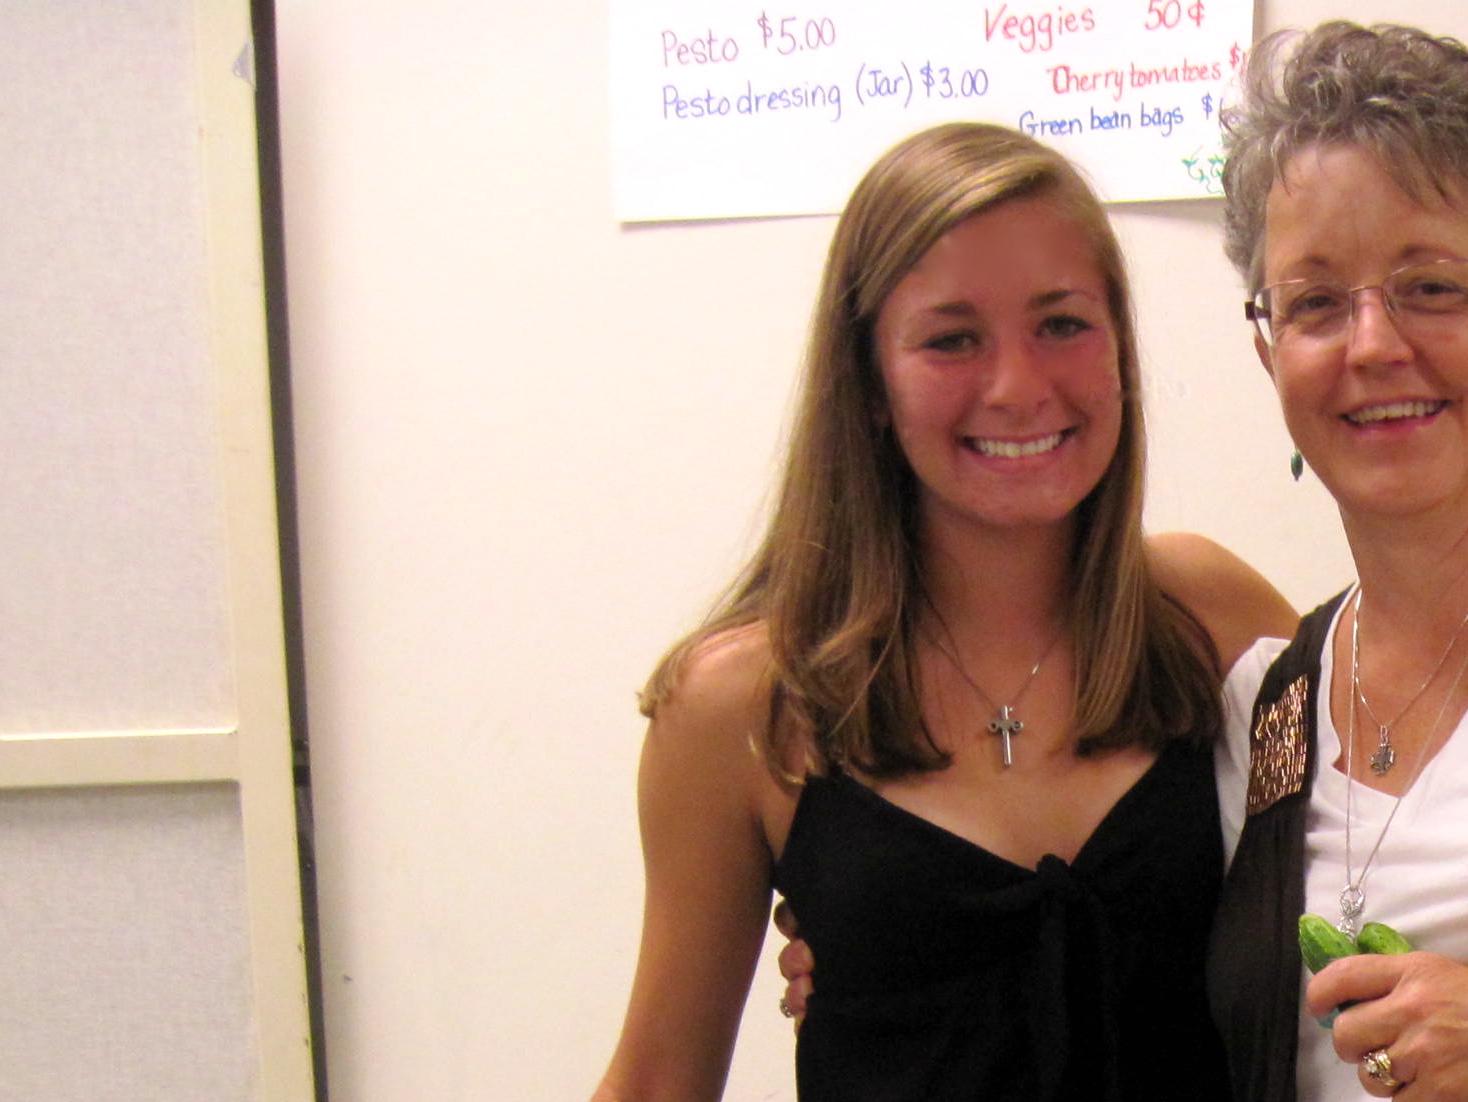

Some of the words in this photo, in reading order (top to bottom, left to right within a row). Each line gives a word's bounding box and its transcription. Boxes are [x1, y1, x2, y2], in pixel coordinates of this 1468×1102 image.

[660, 28, 740, 68] Pesto
[757, 10, 837, 56] $5.00
[985, 4, 1096, 54] Veggies
[661, 84, 732, 120] Pesto
[736, 80, 843, 123] dressing
[856, 60, 914, 109] (Jar)
[920, 60, 990, 99] $3.00
[1045, 63, 1125, 102] Cherry
[1130, 57, 1222, 89] tomatoes
[1018, 110, 1083, 138] Green
[1089, 106, 1132, 131] bean
[1139, 102, 1185, 138] bags
